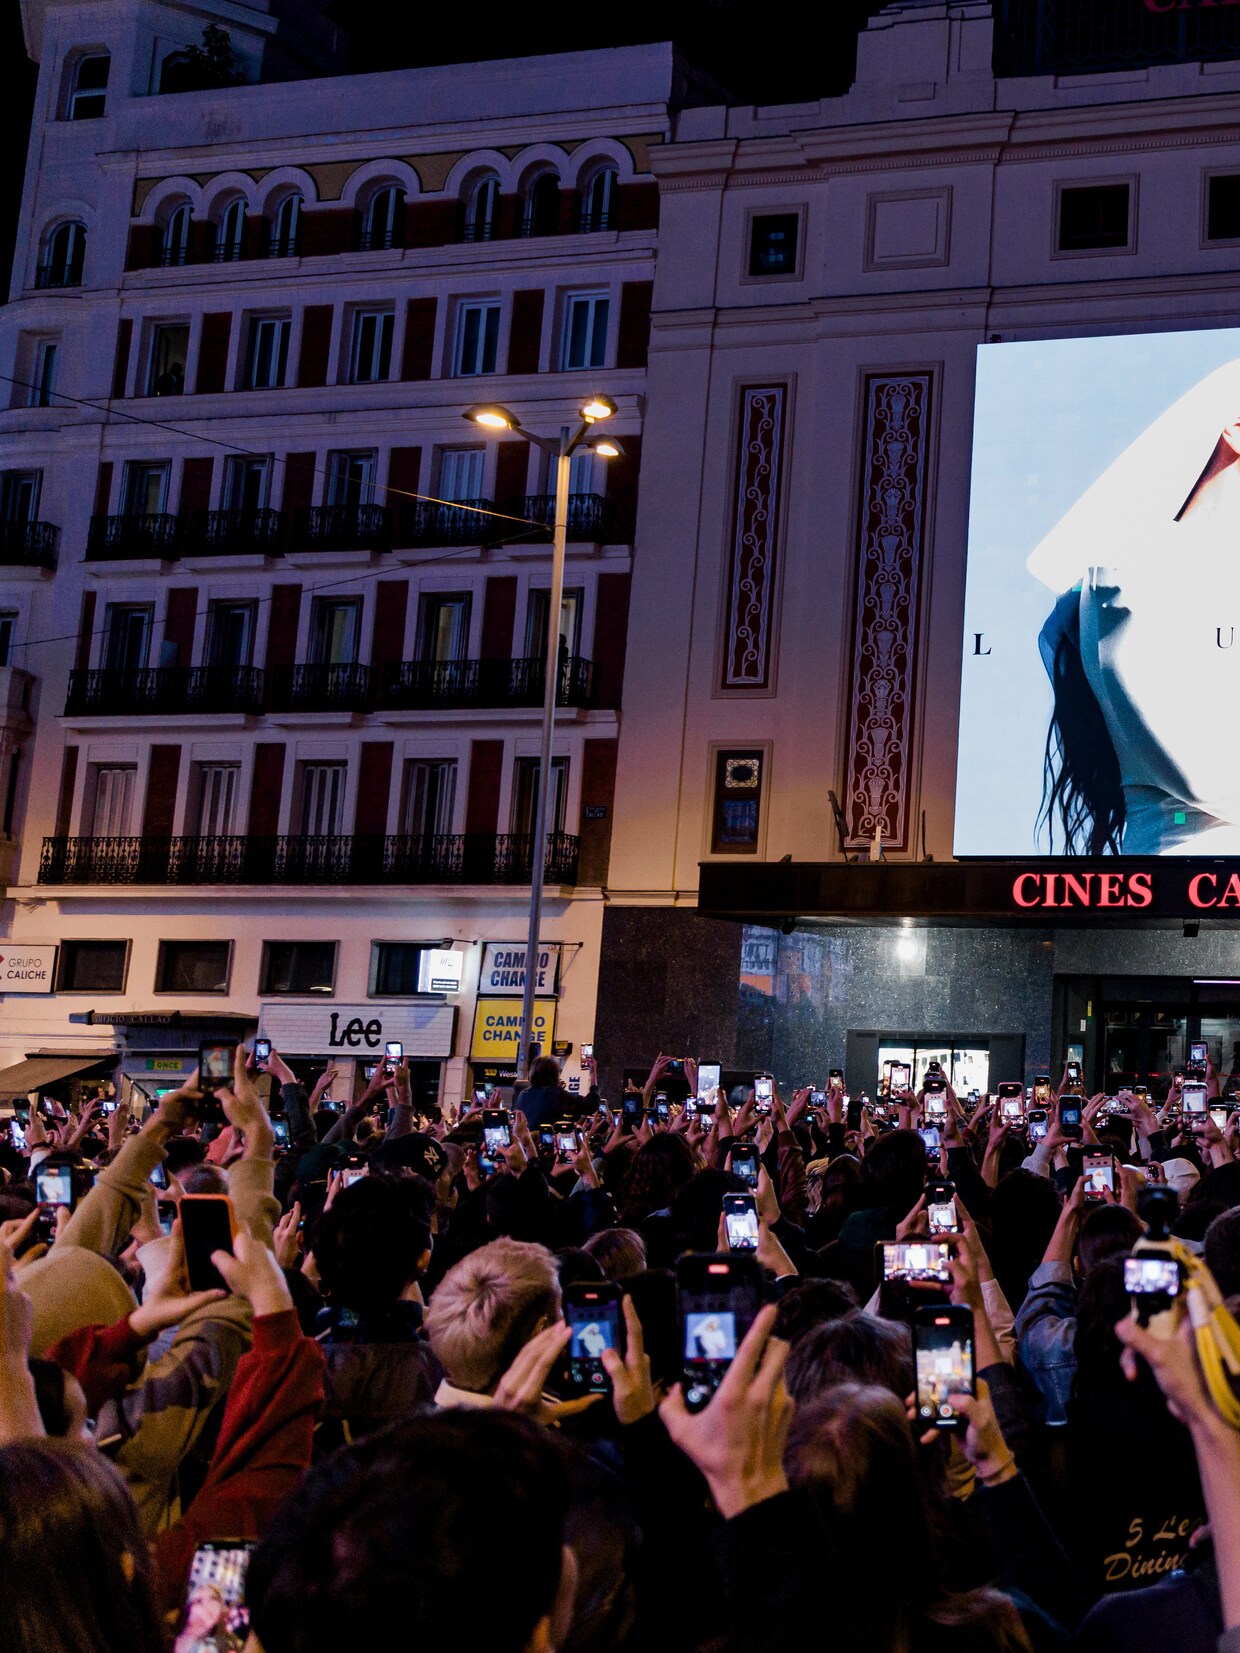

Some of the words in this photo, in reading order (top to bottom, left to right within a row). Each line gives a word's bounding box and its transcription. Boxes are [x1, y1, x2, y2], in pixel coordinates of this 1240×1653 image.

[971, 633, 992, 655] L
[1216, 627, 1234, 649] U
[1012, 872, 1153, 907] CINES
[8, 958, 42, 968] GRUPO
[7, 970, 47, 980] CALICHE
[131, 1015, 171, 1024] CALLAO
[328, 1012, 382, 1047] Lee
[156, 1061, 179, 1069] ONCE
